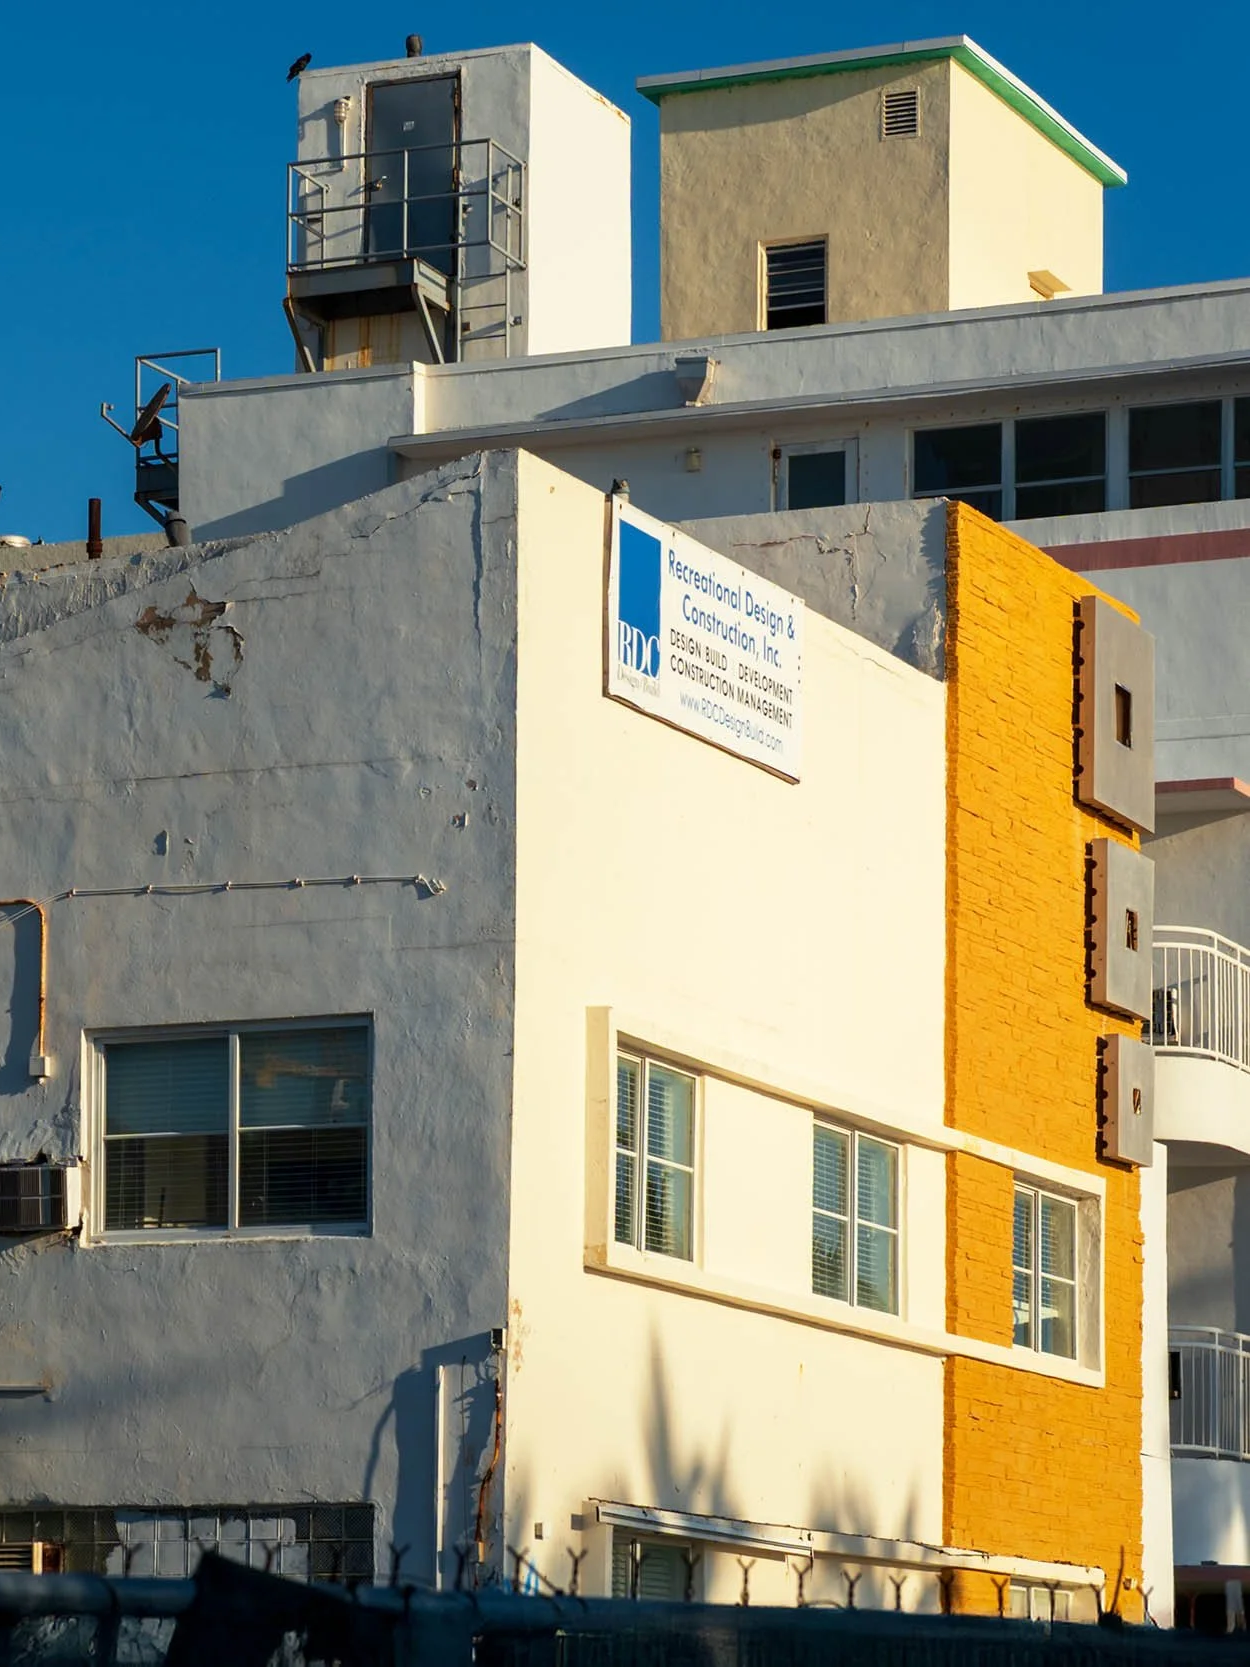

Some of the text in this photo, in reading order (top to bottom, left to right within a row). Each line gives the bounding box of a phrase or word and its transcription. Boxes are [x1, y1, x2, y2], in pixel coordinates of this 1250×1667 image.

[668, 549, 795, 640] Recreational Design &
[682, 594, 782, 669] Construction, Inc.
[617, 620, 660, 680] RDC
[670, 628, 793, 705] DESIGN BUILD DEVELOPMENT
[670, 654, 793, 728] CONSTRUCTION MANAGEMENT
